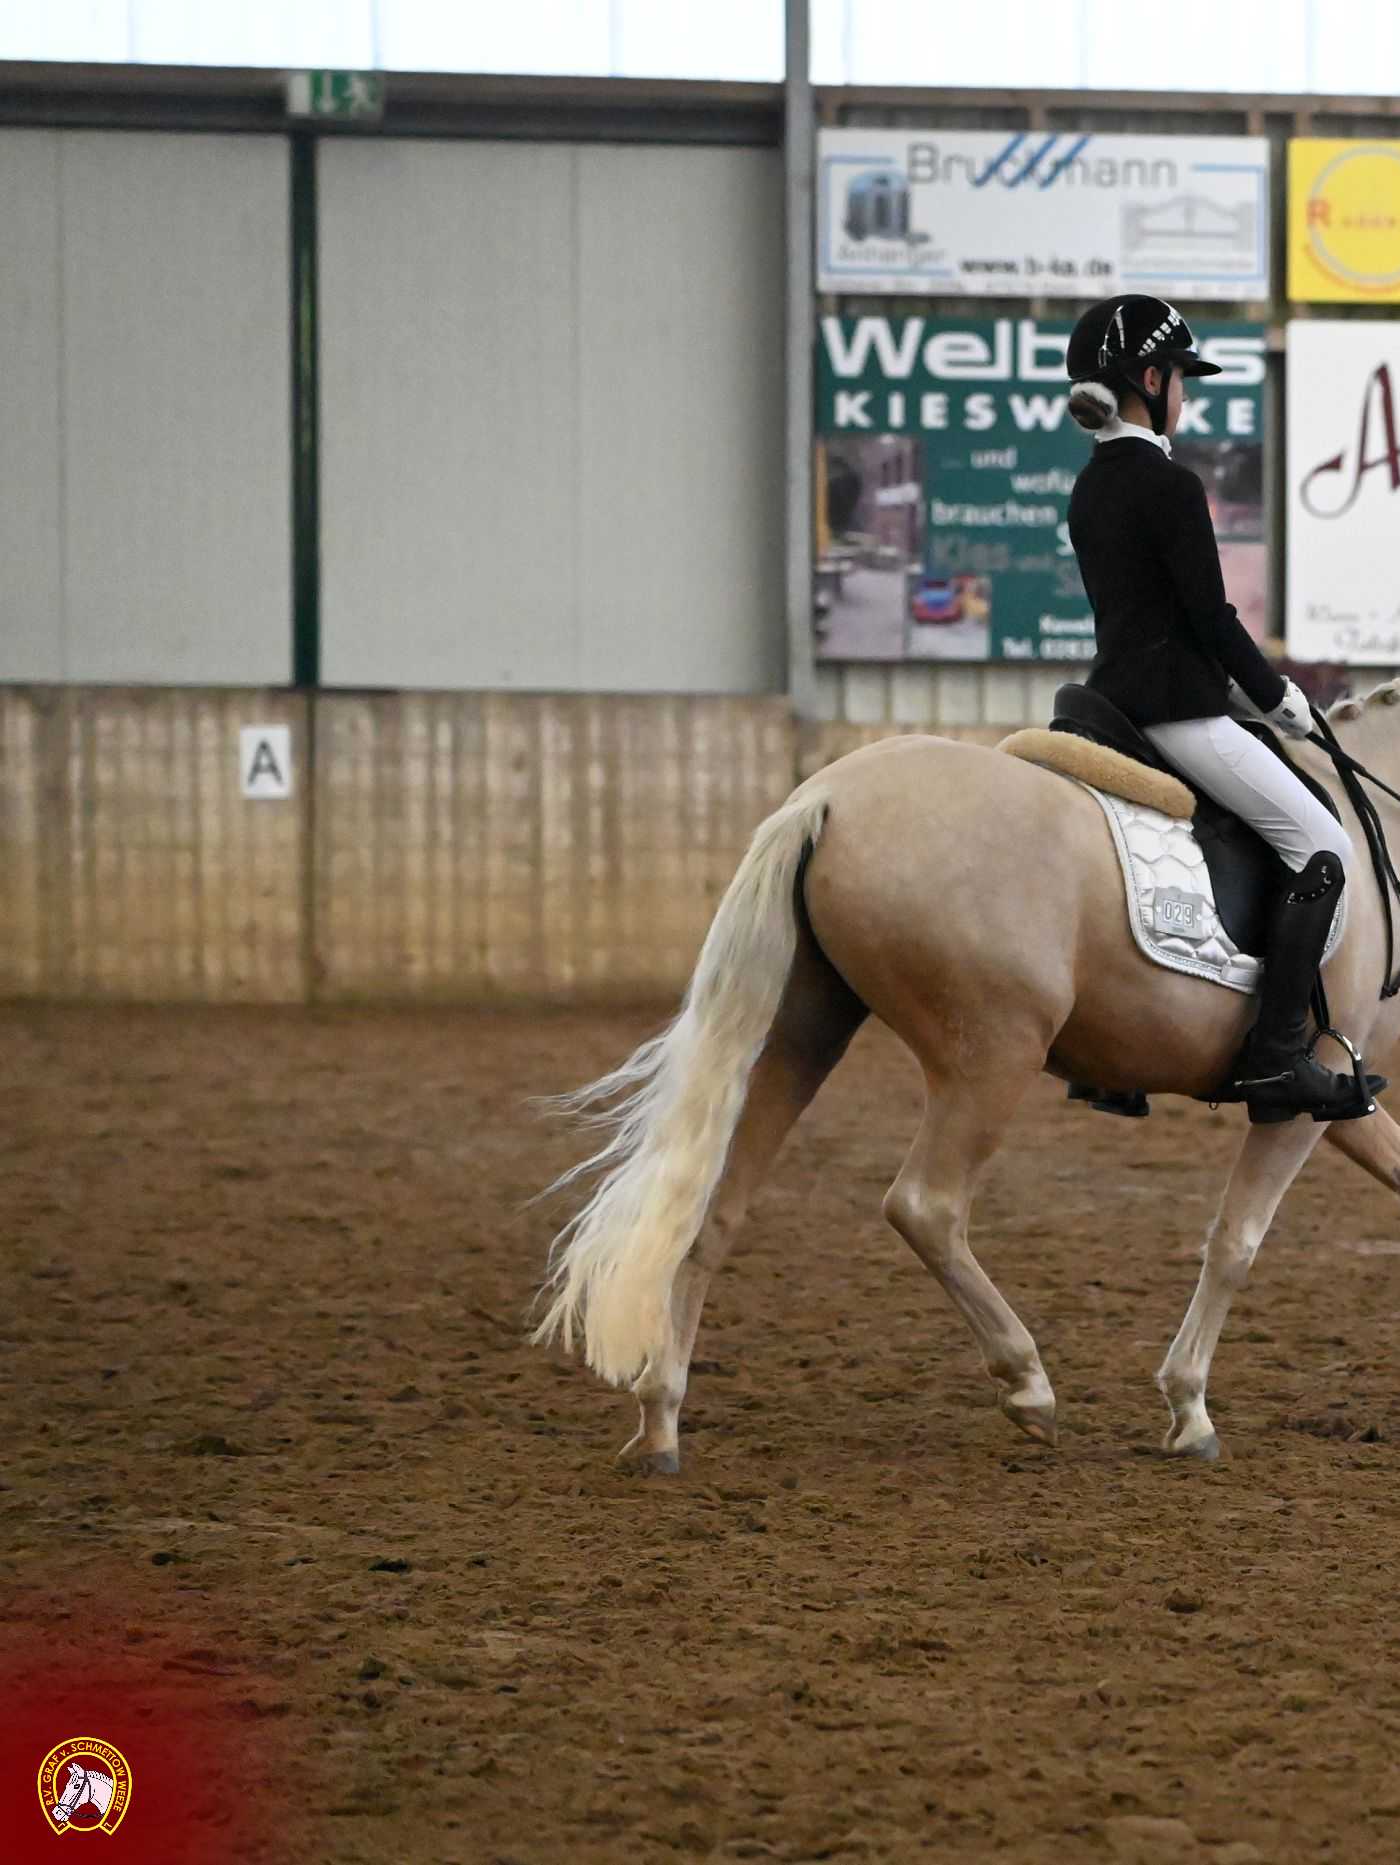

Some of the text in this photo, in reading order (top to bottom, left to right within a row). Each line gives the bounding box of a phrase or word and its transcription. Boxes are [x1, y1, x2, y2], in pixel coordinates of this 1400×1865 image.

[823, 318, 1267, 385] Welbs
[834, 391, 1255, 434] KIESWKE
[971, 445, 1018, 469] und
[247, 739, 285, 787] A
[1164, 901, 1192, 925] 029
